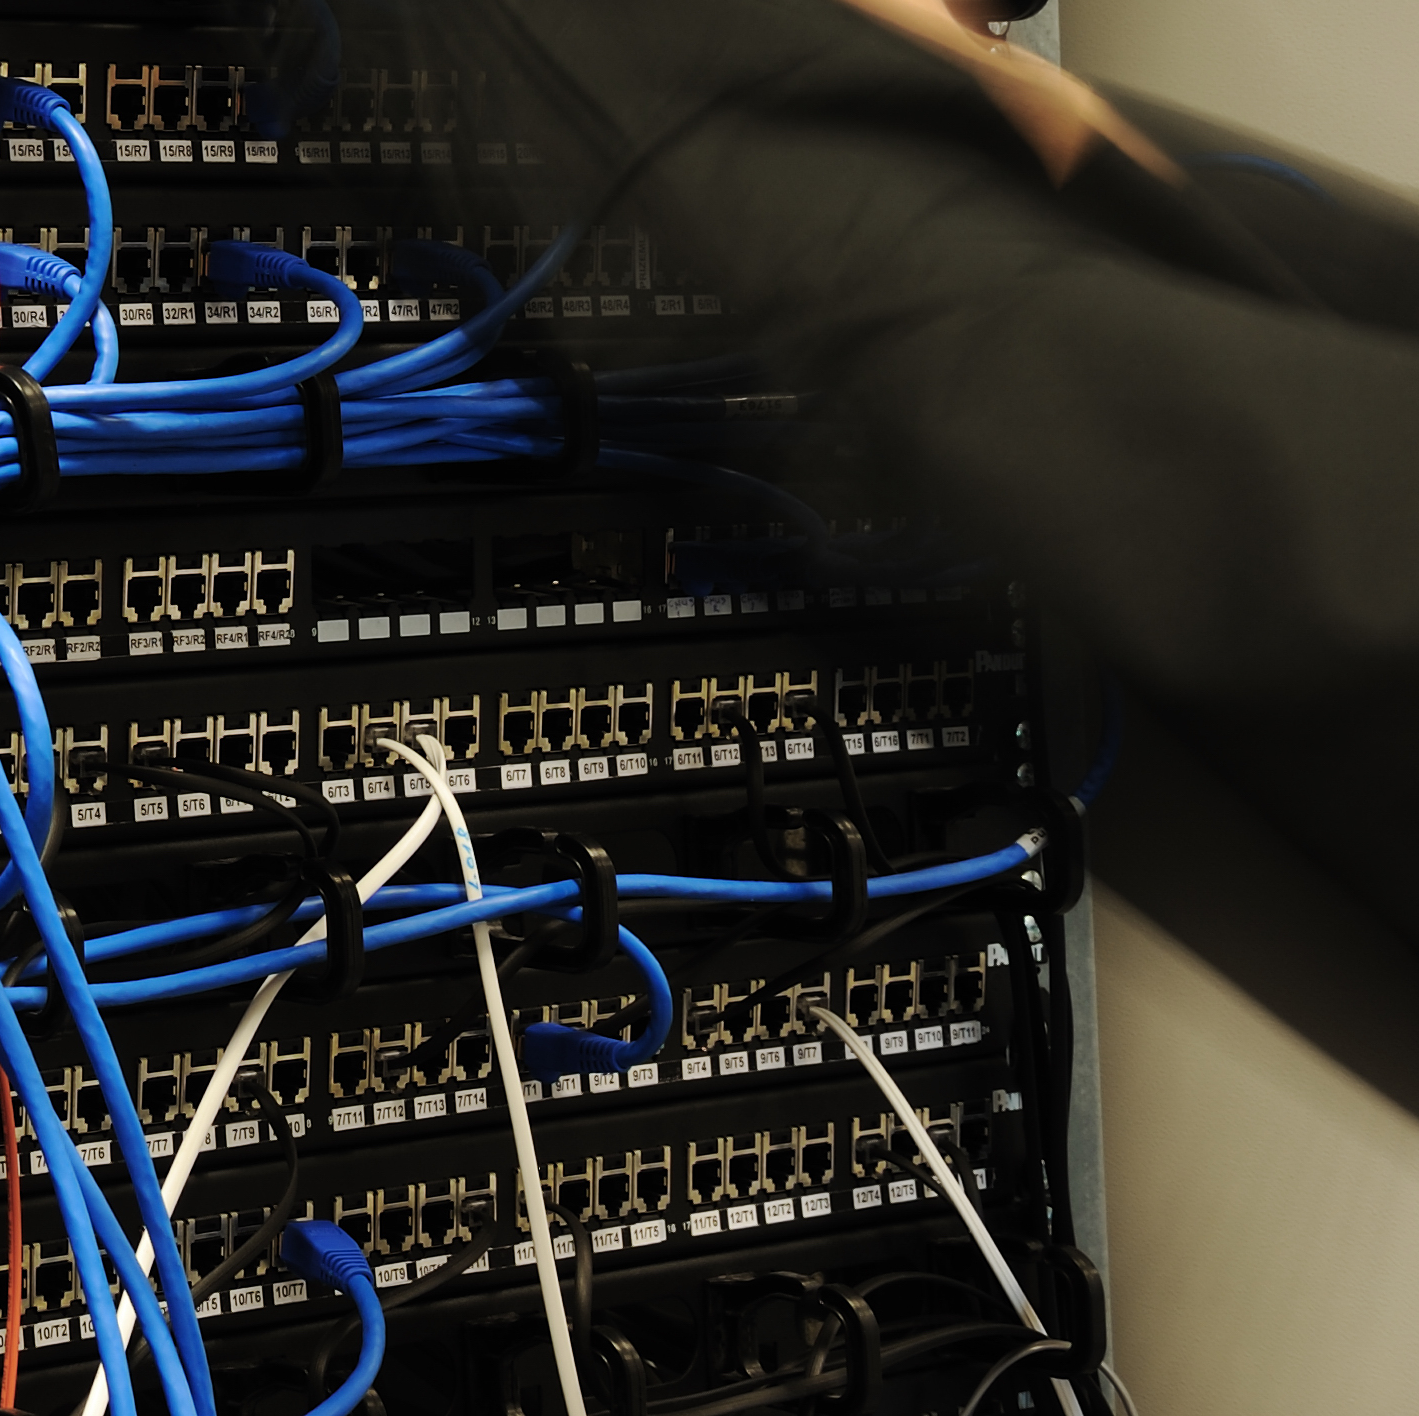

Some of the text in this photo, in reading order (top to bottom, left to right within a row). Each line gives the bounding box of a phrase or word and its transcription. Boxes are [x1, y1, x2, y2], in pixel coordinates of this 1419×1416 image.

[11, 143, 42, 157] 15/R5
[118, 144, 147, 157] 15/R7
[162, 144, 192, 158] 15/R8
[204, 144, 233, 158] 15/R9
[246, 145, 276, 158] 15/R10
[301, 146, 330, 159] 15/R11
[122, 308, 152, 321] 30/R6
[165, 307, 194, 320] 32/R1
[207, 306, 236, 319] 34/R1
[249, 306, 279, 319] 34/R2
[309, 306, 338, 319] 36/R1
[391, 305, 419, 318] 47/R1
[431, 304, 459, 317] 47/R2
[13, 311, 44, 325] 30/R4
[131, 636, 162, 649] RF3/R1
[174, 634, 205, 647] RF3/R2
[217, 632, 248, 645] RF4/R1
[24, 642, 55, 656] RF2/R1
[67, 640, 100, 653] RF2/R2
[874, 735, 898, 748] 6/T16
[714, 748, 739, 762] 6/T12
[788, 742, 813, 756] 6/T14
[620, 756, 646, 771] 6/T10
[677, 752, 701, 767] 6/T11
[545, 766, 565, 779] 6/T8
[584, 761, 604, 775] 6/T9
[448, 774, 469, 787] 6/T6
[506, 769, 526, 782] 6/T7
[328, 785, 350, 799] 6/T3
[368, 781, 389, 794] 6/T4
[140, 802, 163, 816] 5/T5
[183, 798, 205, 812] 5/T6
[78, 807, 101, 821] 5/T4
[918, 1030, 942, 1044] 9/T10
[952, 1026, 976, 1041] 9/T11
[885, 1034, 904, 1048] 9/T9
[760, 1050, 780, 1065] 9/T6
[797, 1046, 817, 1060] 9/T7
[687, 1060, 707, 1075] 9/T4
[724, 1056, 745, 1069] 9/T5
[632, 1067, 654, 1082] 9/T3
[417, 1099, 445, 1114] 7/T13
[458, 1093, 485, 1107] 7/T14
[337, 1111, 363, 1125] 7/T11
[376, 1104, 403, 1119] 7/T12
[232, 1126, 254, 1140] 7/T9
[82, 1146, 104, 1160] 7/T6
[856, 1190, 880, 1204] 12/T4
[890, 1185, 915, 1198] 12/T5
[766, 1203, 792, 1217] 12/T2
[804, 1199, 829, 1212] 12/T3
[694, 1215, 719, 1230] 11/T6
[730, 1210, 754, 1224] 12/T1
[594, 1233, 620, 1247] 11/T4
[634, 1227, 660, 1240] 11/T5
[378, 1268, 406, 1282] 10/T9
[275, 1284, 305, 1298] 10/T7
[232, 1291, 261, 1306] 10/T6
[36, 1324, 67, 1341] 10/T2
